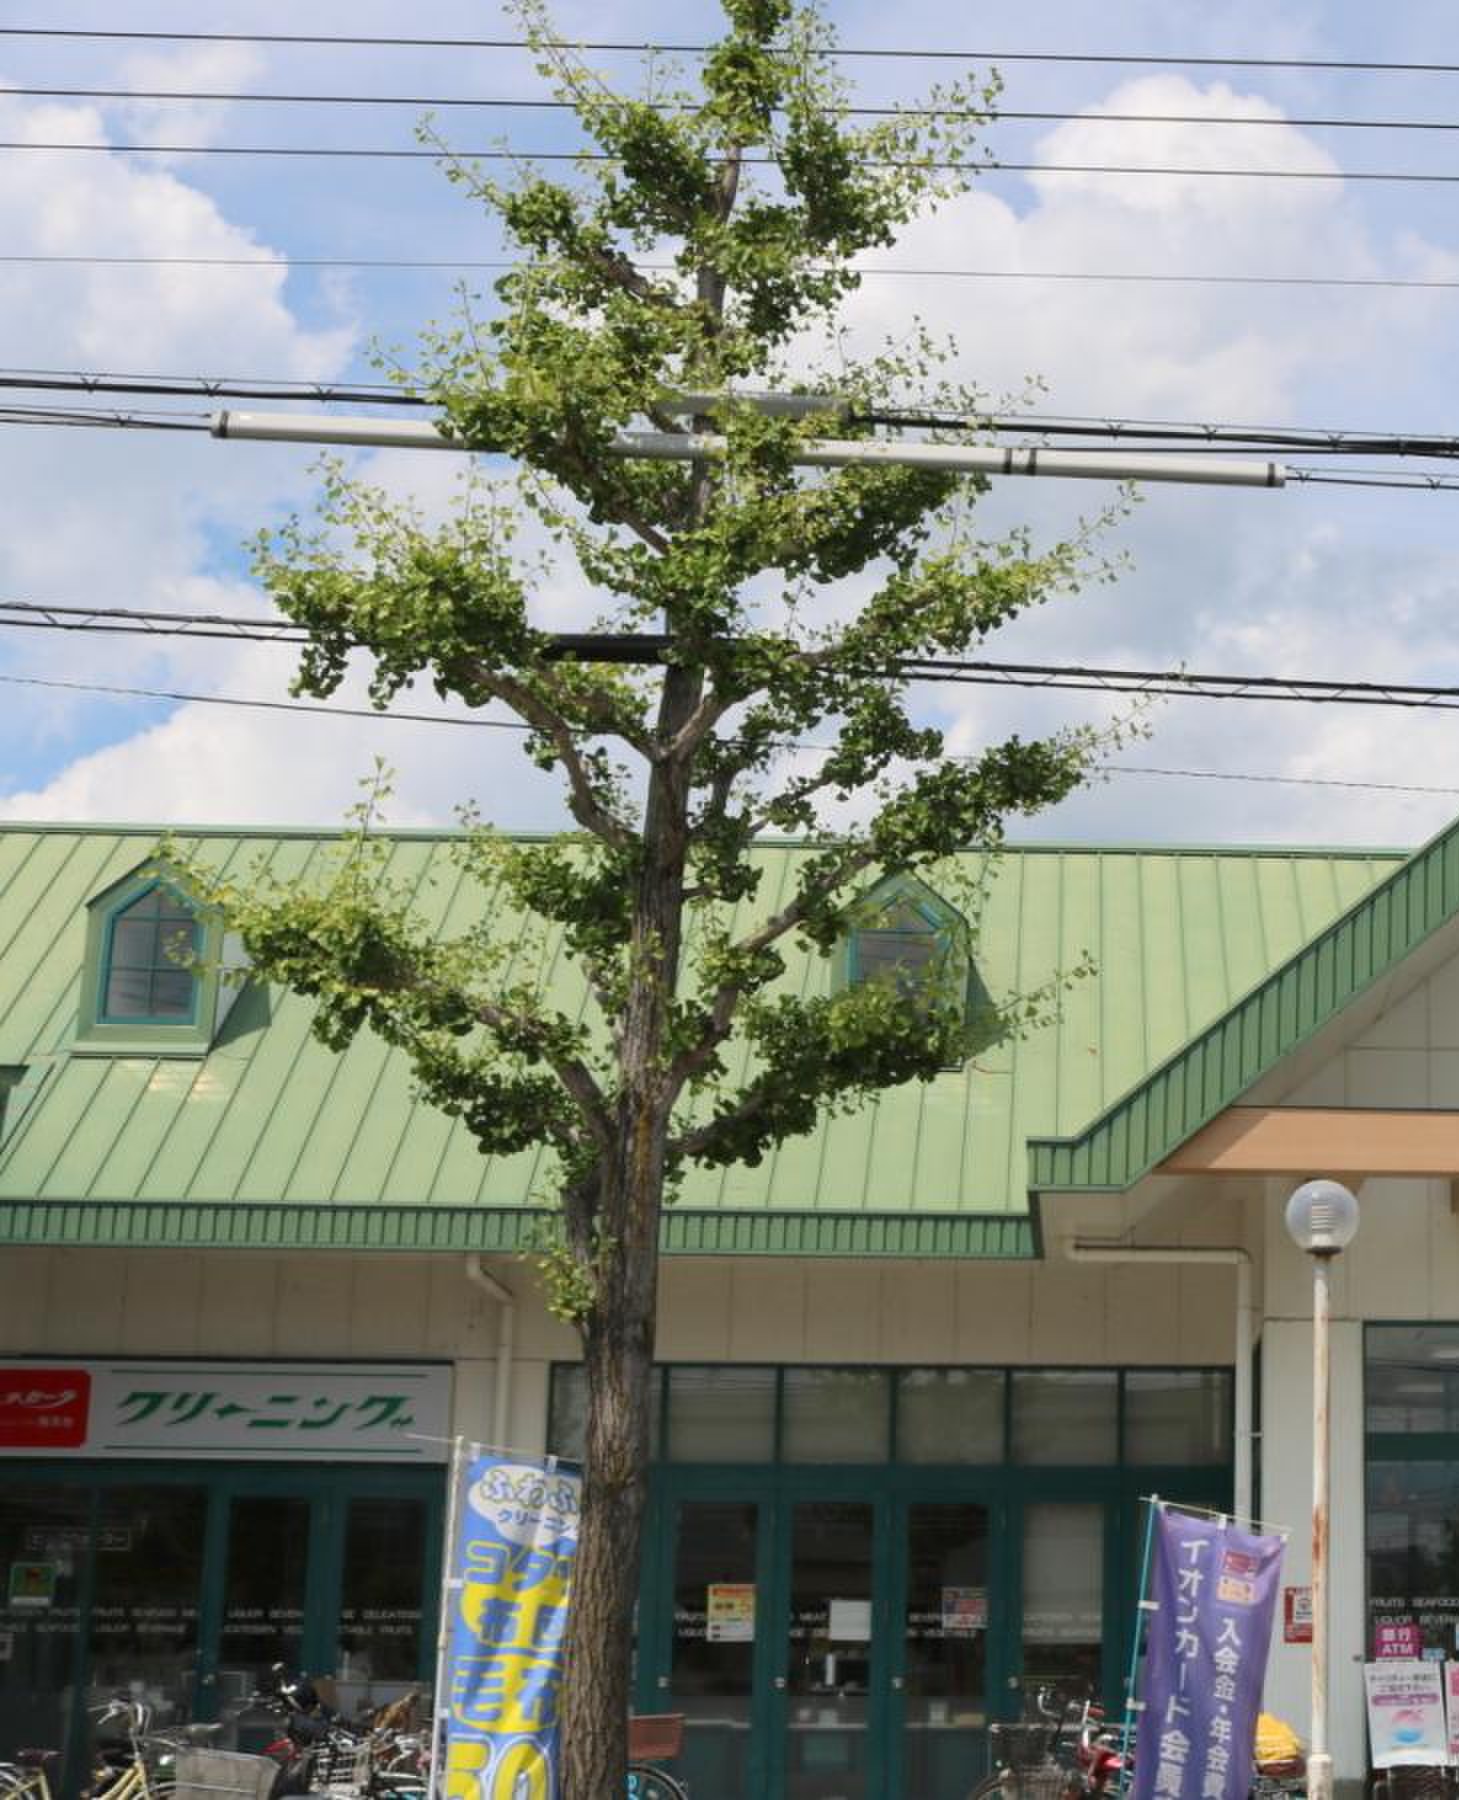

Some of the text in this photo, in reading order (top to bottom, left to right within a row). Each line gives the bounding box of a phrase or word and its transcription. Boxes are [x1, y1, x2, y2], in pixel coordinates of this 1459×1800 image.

[114, 1391, 416, 1431] クリーニング
[481, 1469, 578, 1516] ふわふ
[1152, 1539, 1210, 1800] イオンカード会員
[1380, 1643, 1414, 1656] ATM
